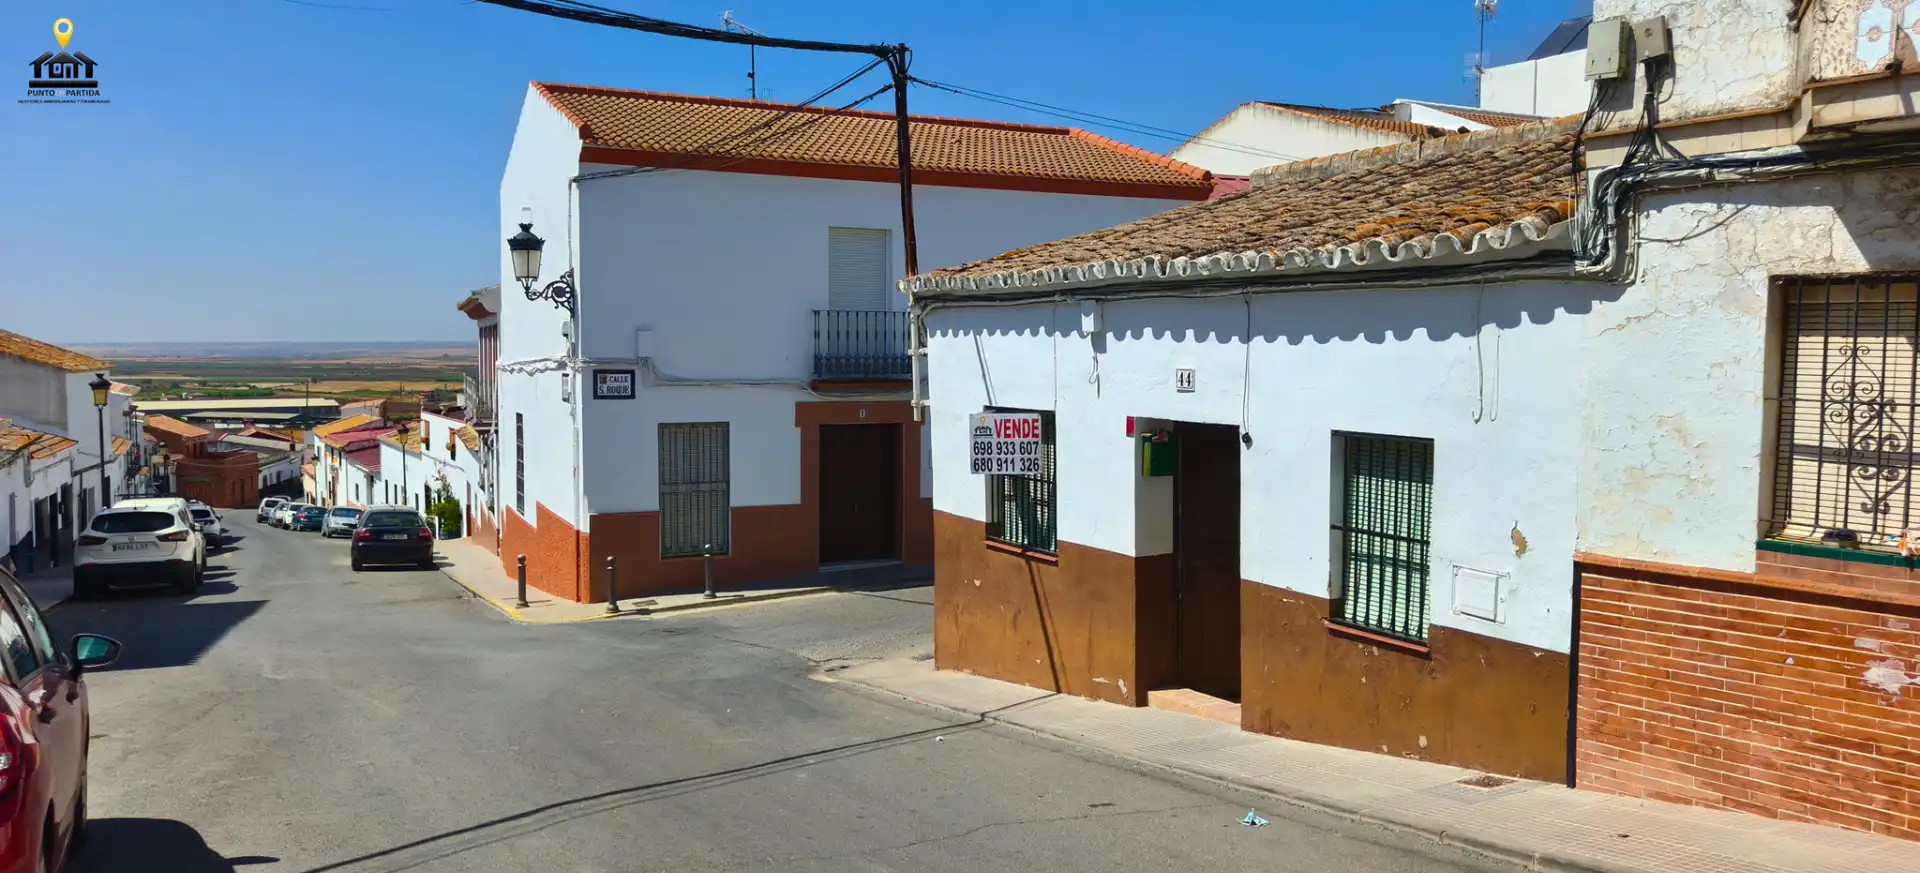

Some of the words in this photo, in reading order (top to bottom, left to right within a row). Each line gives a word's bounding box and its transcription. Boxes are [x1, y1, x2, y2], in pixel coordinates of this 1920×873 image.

[609, 375, 628, 383] CALLE
[1177, 371, 1191, 387] 44
[606, 385, 630, 394] ROQUE
[994, 418, 1040, 439] VENDE
[973, 441, 993, 456] 698
[996, 441, 1016, 456] 933
[1019, 441, 1040, 456] 607
[973, 457, 993, 472] 680
[996, 457, 1015, 472] 911
[1020, 457, 1040, 472] 326
